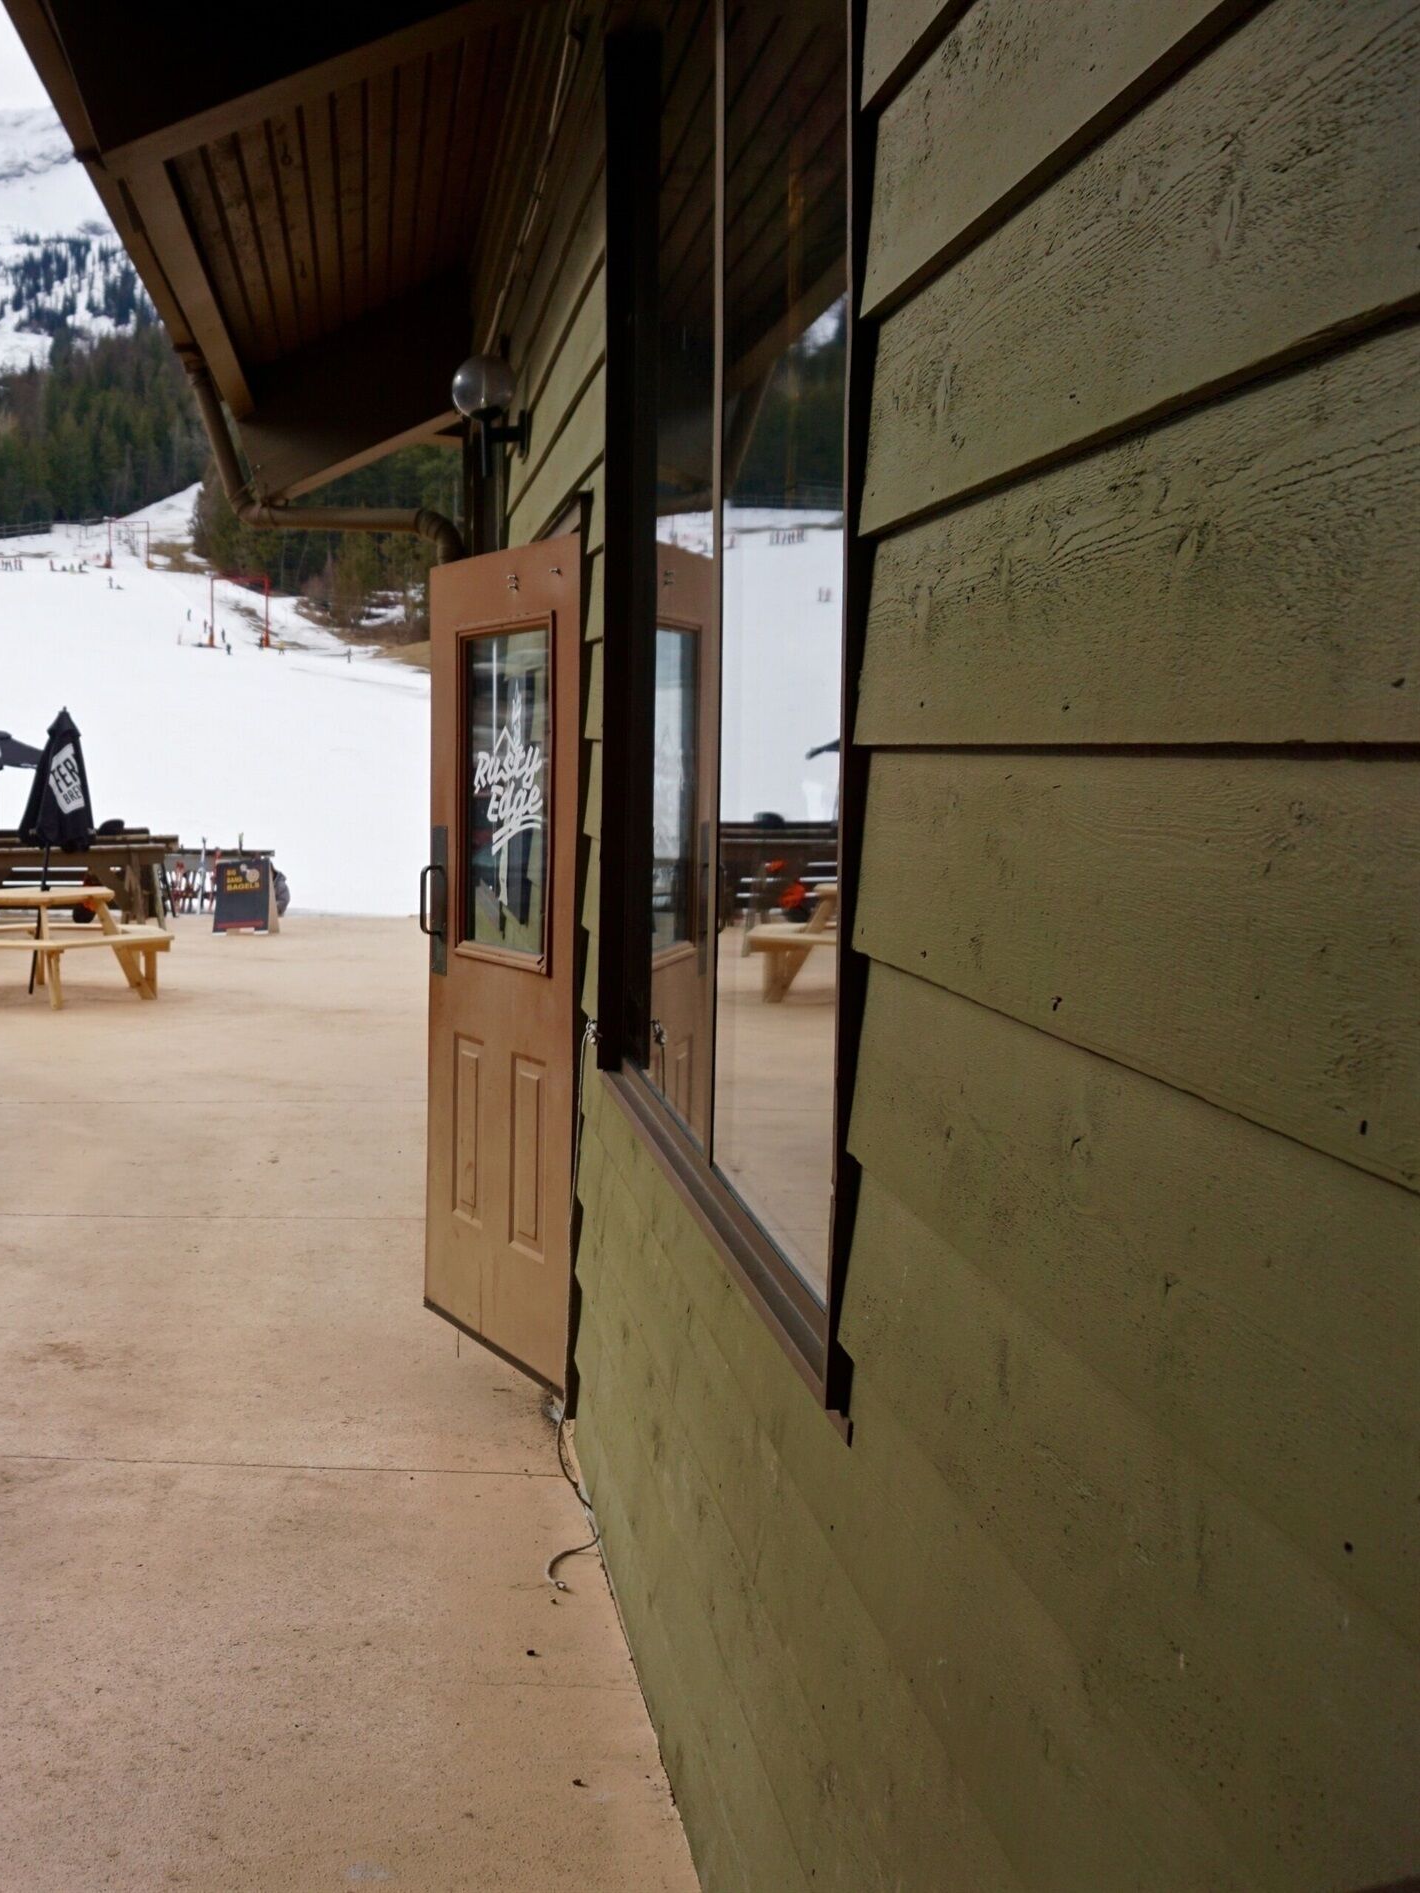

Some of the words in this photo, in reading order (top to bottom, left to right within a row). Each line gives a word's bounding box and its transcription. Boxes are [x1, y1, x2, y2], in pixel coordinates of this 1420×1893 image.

[474, 745, 542, 794] Rusty
[487, 781, 543, 829] Edge
[226, 881, 260, 891] BAGELS
